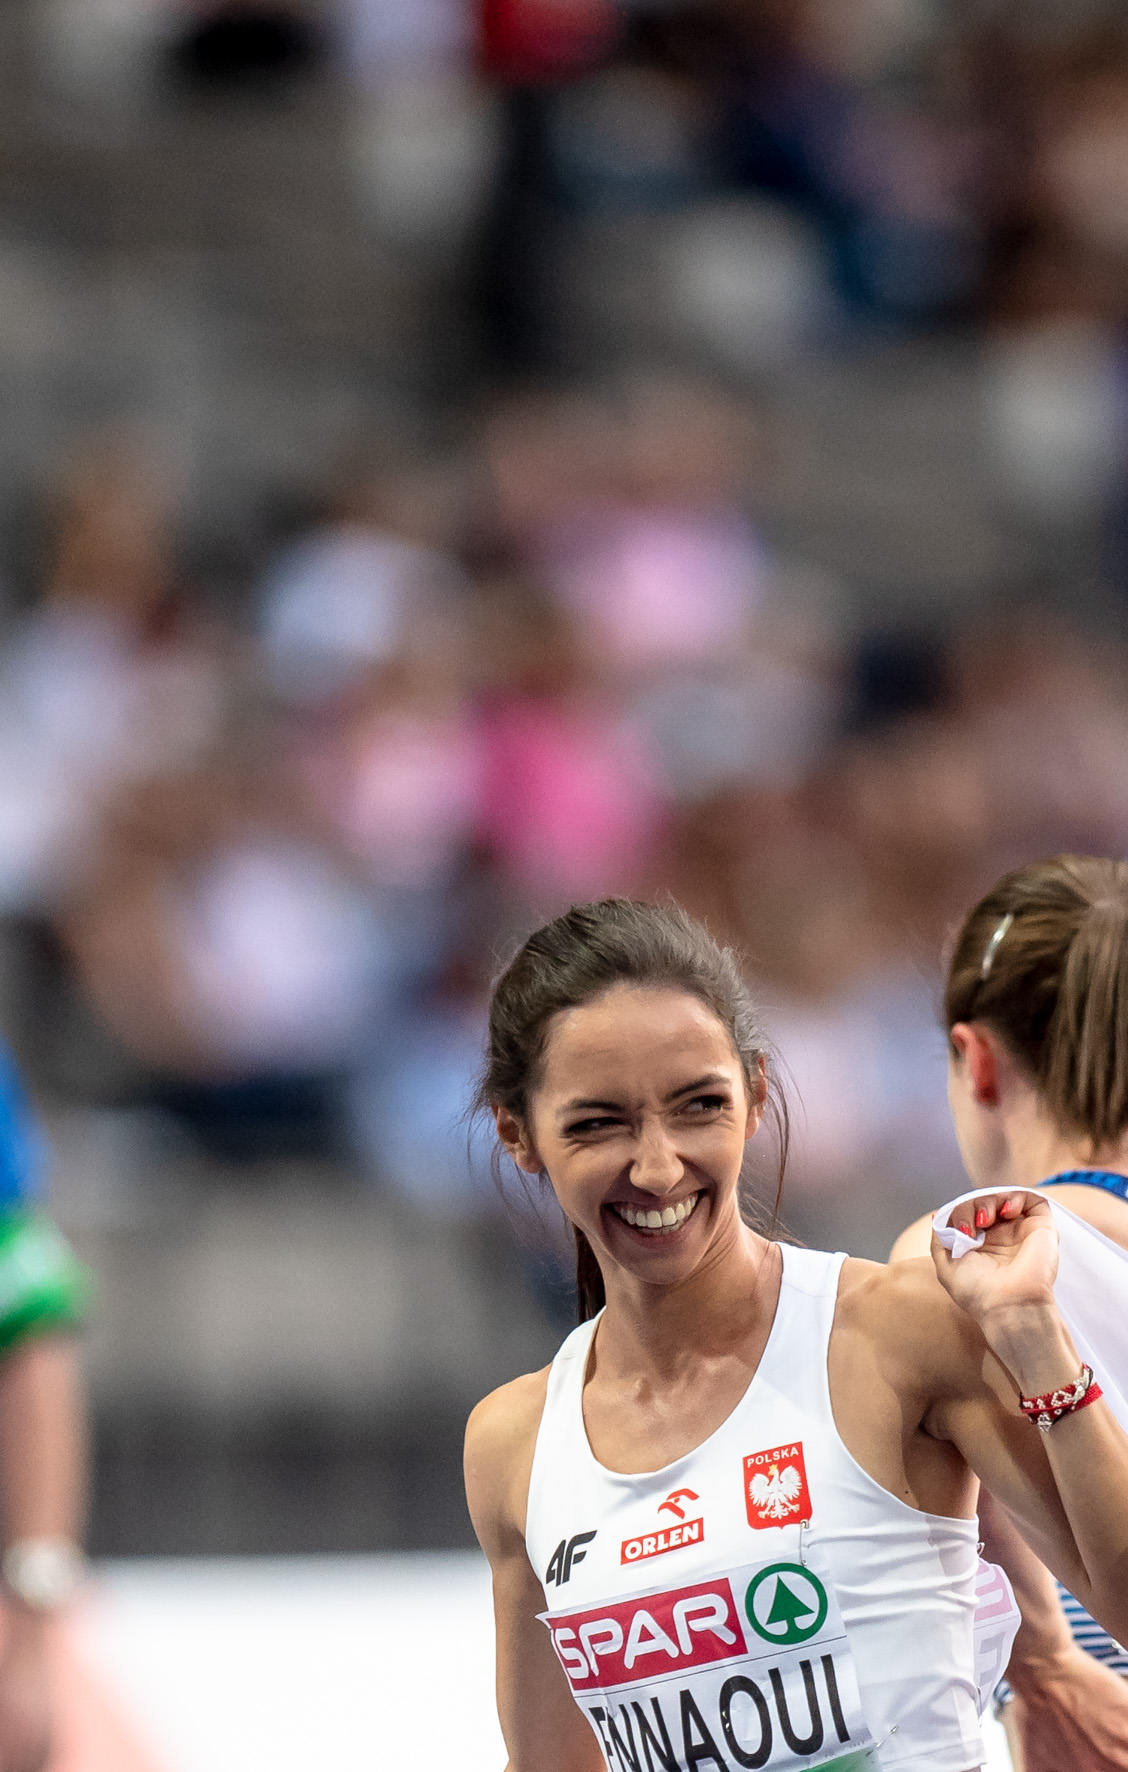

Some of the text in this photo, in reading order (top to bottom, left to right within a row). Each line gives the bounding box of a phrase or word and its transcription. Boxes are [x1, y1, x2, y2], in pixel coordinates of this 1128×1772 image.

[746, 1446, 800, 1468] POLSKA
[624, 1522, 700, 1561] ORLEN
[554, 1593, 738, 1680] SPAR
